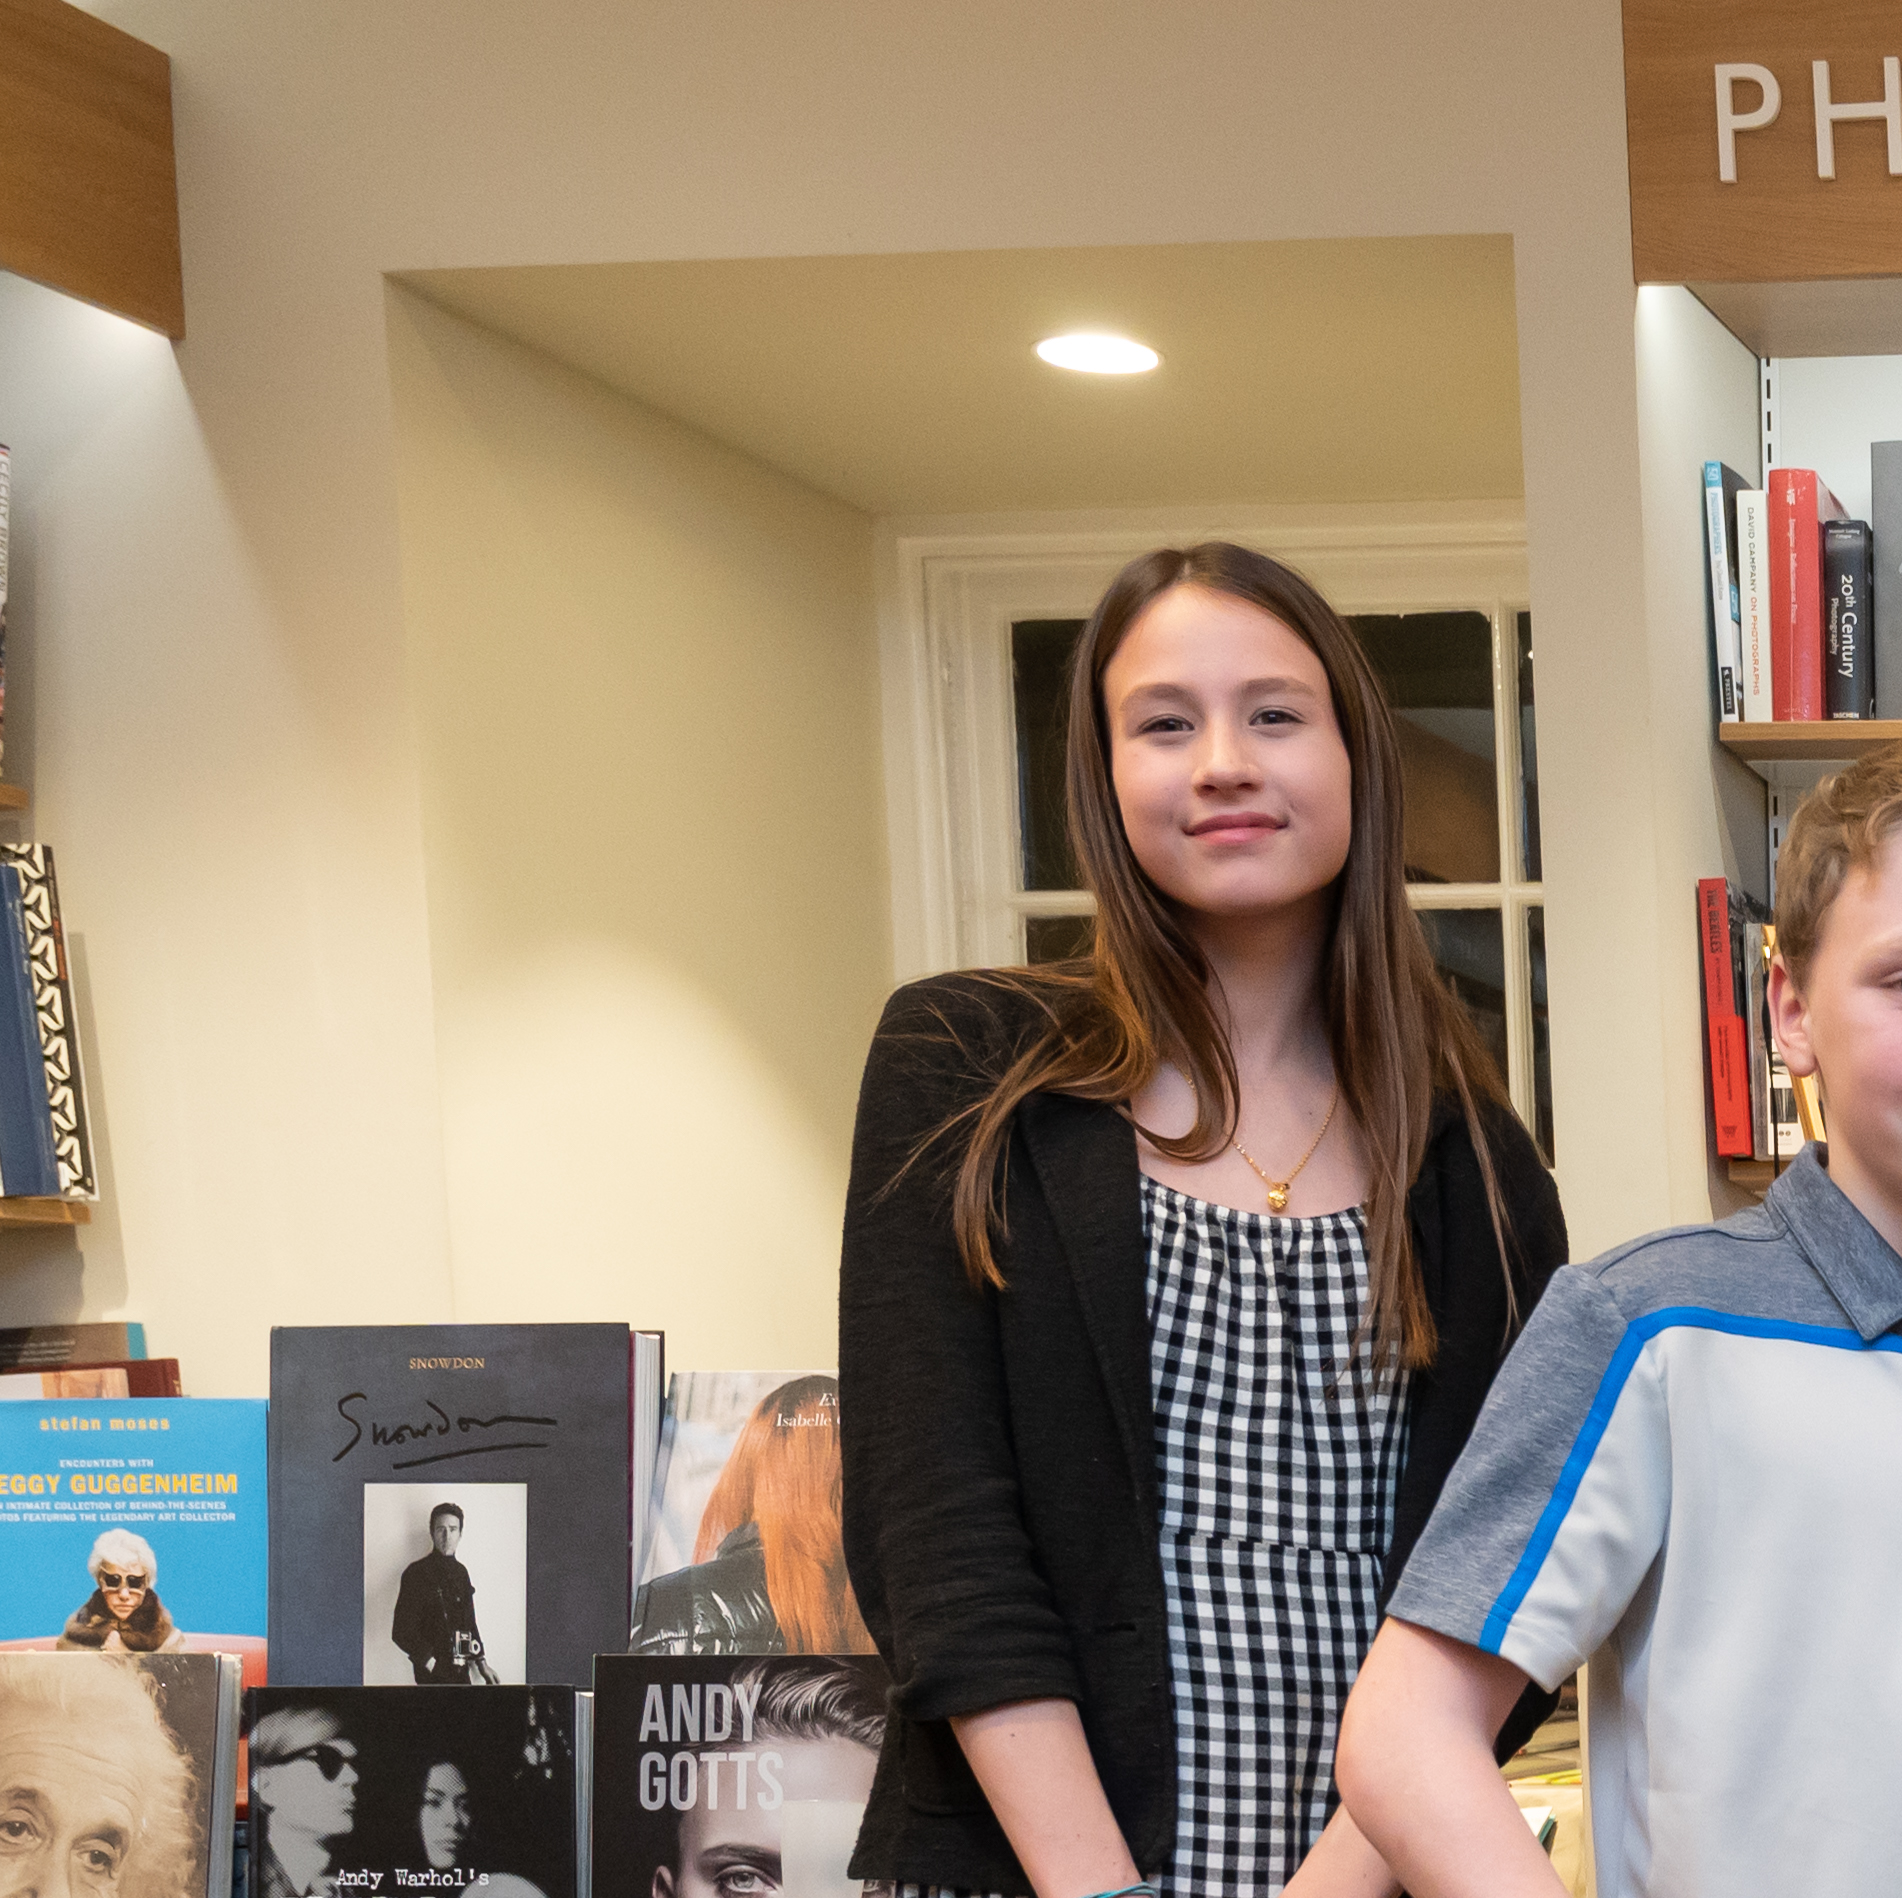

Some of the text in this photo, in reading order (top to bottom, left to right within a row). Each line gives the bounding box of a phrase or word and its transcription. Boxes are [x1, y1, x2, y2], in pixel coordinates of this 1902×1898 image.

[1747, 507, 1760, 696] DAVID CAMPANY ON PHOTOGRAPHS
[1828, 597, 1839, 656] Photography
[1838, 574, 1858, 678] 20th Century
[409, 1356, 486, 1370] SNOWDON
[40, 1415, 170, 1431] stefan moses
[776, 1412, 832, 1427] Isabelle
[59, 1459, 154, 1468] ENCOUNTERS WITH
[0, 1474, 238, 1494] EGGY GUGGENHEIM
[6, 1502, 227, 1511] INTIMATE COLLECTION OF BEHIND-THE-SCENES
[23, 1513, 236, 1522] FEATURING THE LEGENDARY ART COLLECTOR
[639, 1682, 763, 1743] ANDY
[639, 1751, 784, 1811] GOTTS
[336, 1867, 489, 1890] Andy Warhol's
